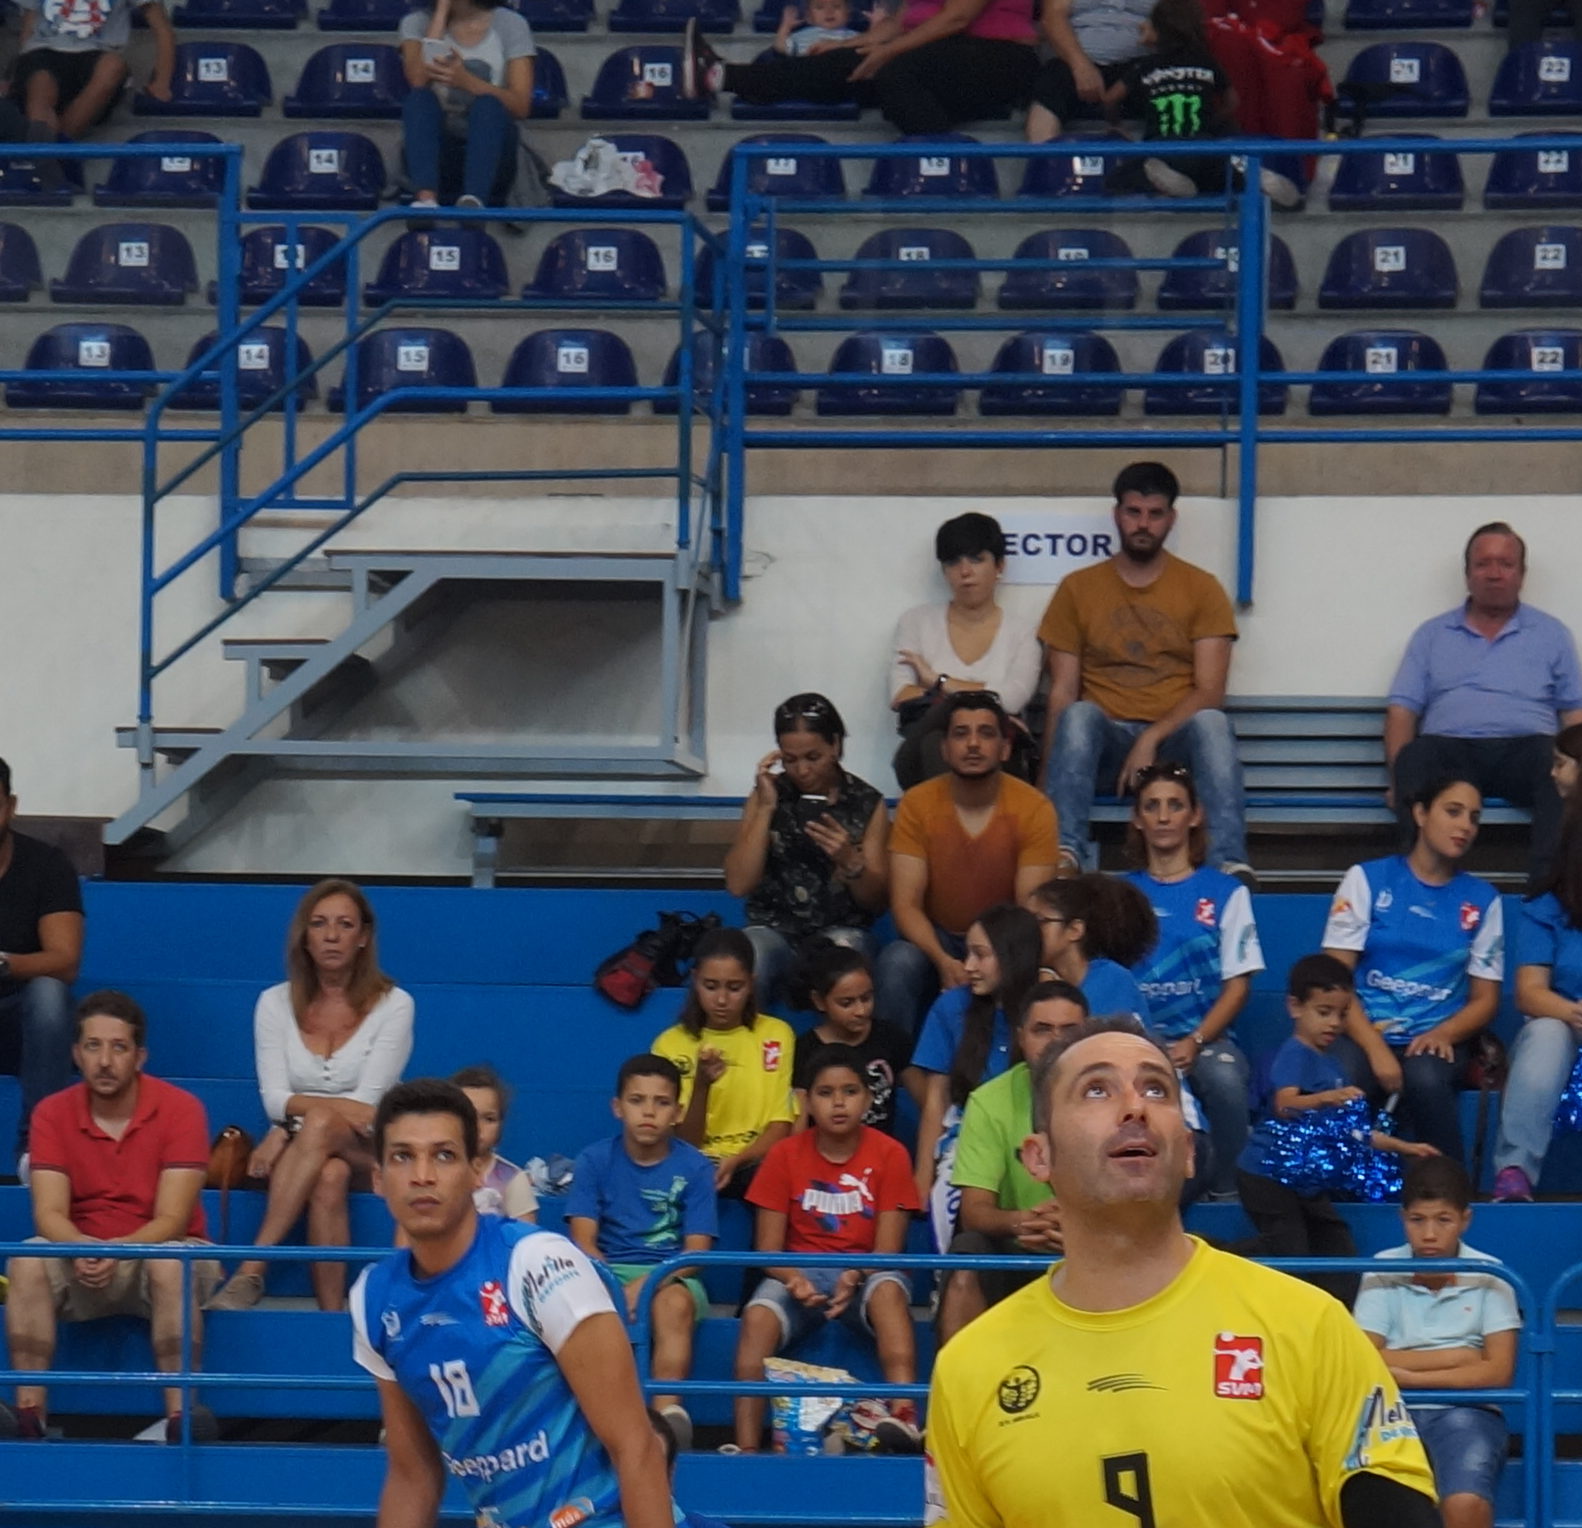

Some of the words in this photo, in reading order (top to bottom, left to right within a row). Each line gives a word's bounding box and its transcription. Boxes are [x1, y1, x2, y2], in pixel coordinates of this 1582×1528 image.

[1003, 533, 1114, 557] ECTOR
[428, 1359, 481, 1418] 18
[1217, 1381, 1263, 1397] SVM
